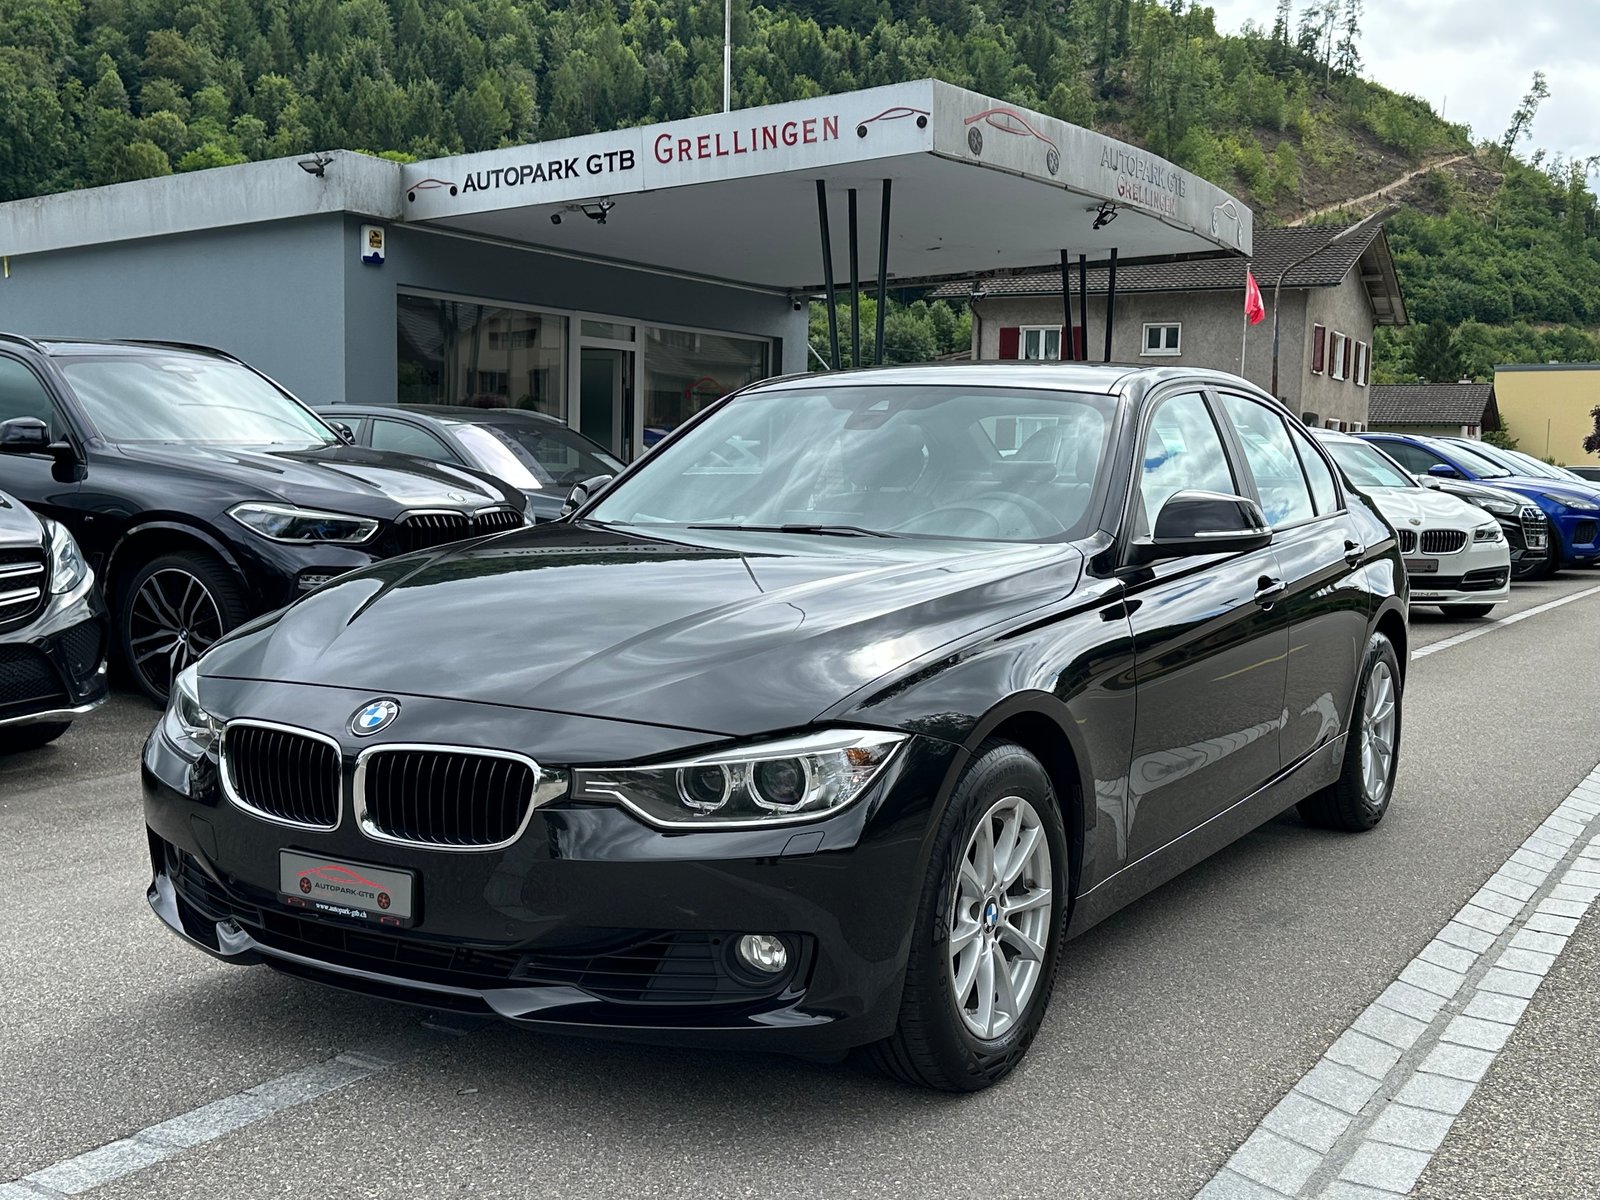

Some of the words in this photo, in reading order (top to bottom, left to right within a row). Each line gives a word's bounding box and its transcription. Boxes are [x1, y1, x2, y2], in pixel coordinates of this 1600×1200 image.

[462, 157, 580, 193] AUTOPARK
[586, 149, 635, 175] GTB
[1100, 145, 1165, 190] AUTOPARK
[1167, 171, 1186, 198] GTB
[314, 882, 375, 899] AUTOPARK-GTB
